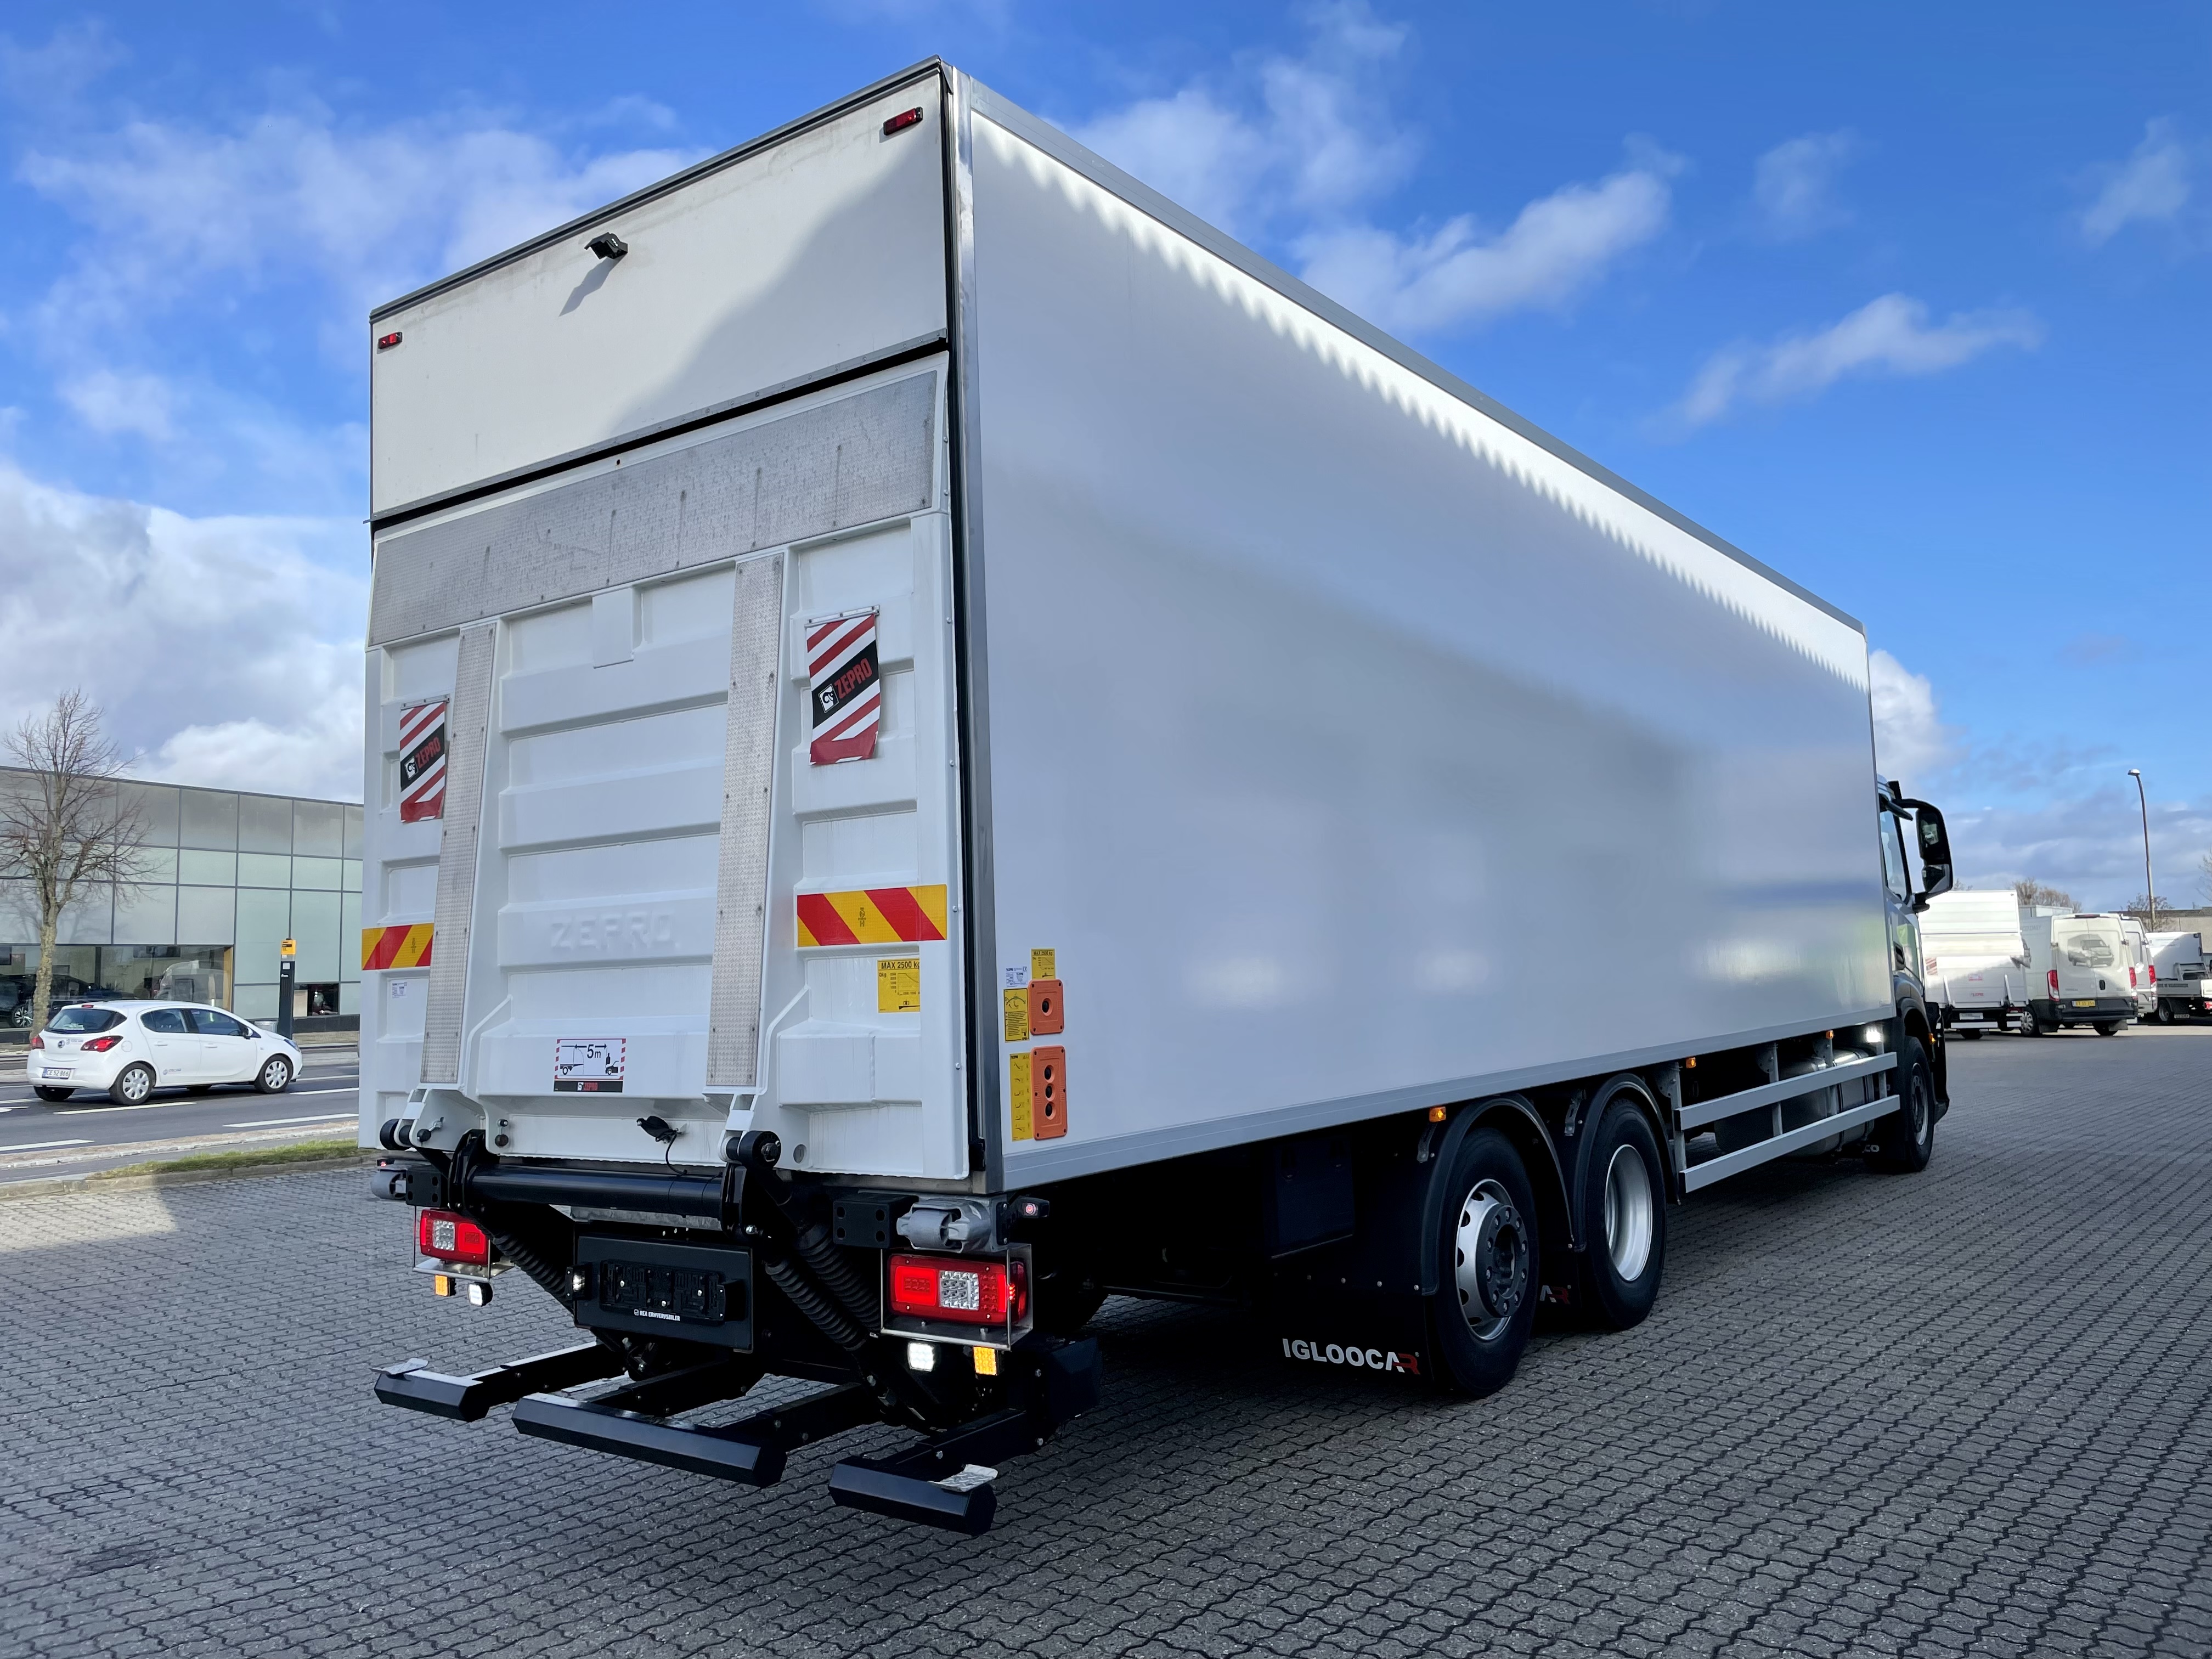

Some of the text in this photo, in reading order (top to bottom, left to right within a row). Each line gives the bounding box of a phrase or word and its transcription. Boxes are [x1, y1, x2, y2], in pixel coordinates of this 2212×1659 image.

[834, 658, 872, 699] ZEPRO
[415, 736, 441, 769] ZEPRO
[551, 911, 675, 949] ZEPRO
